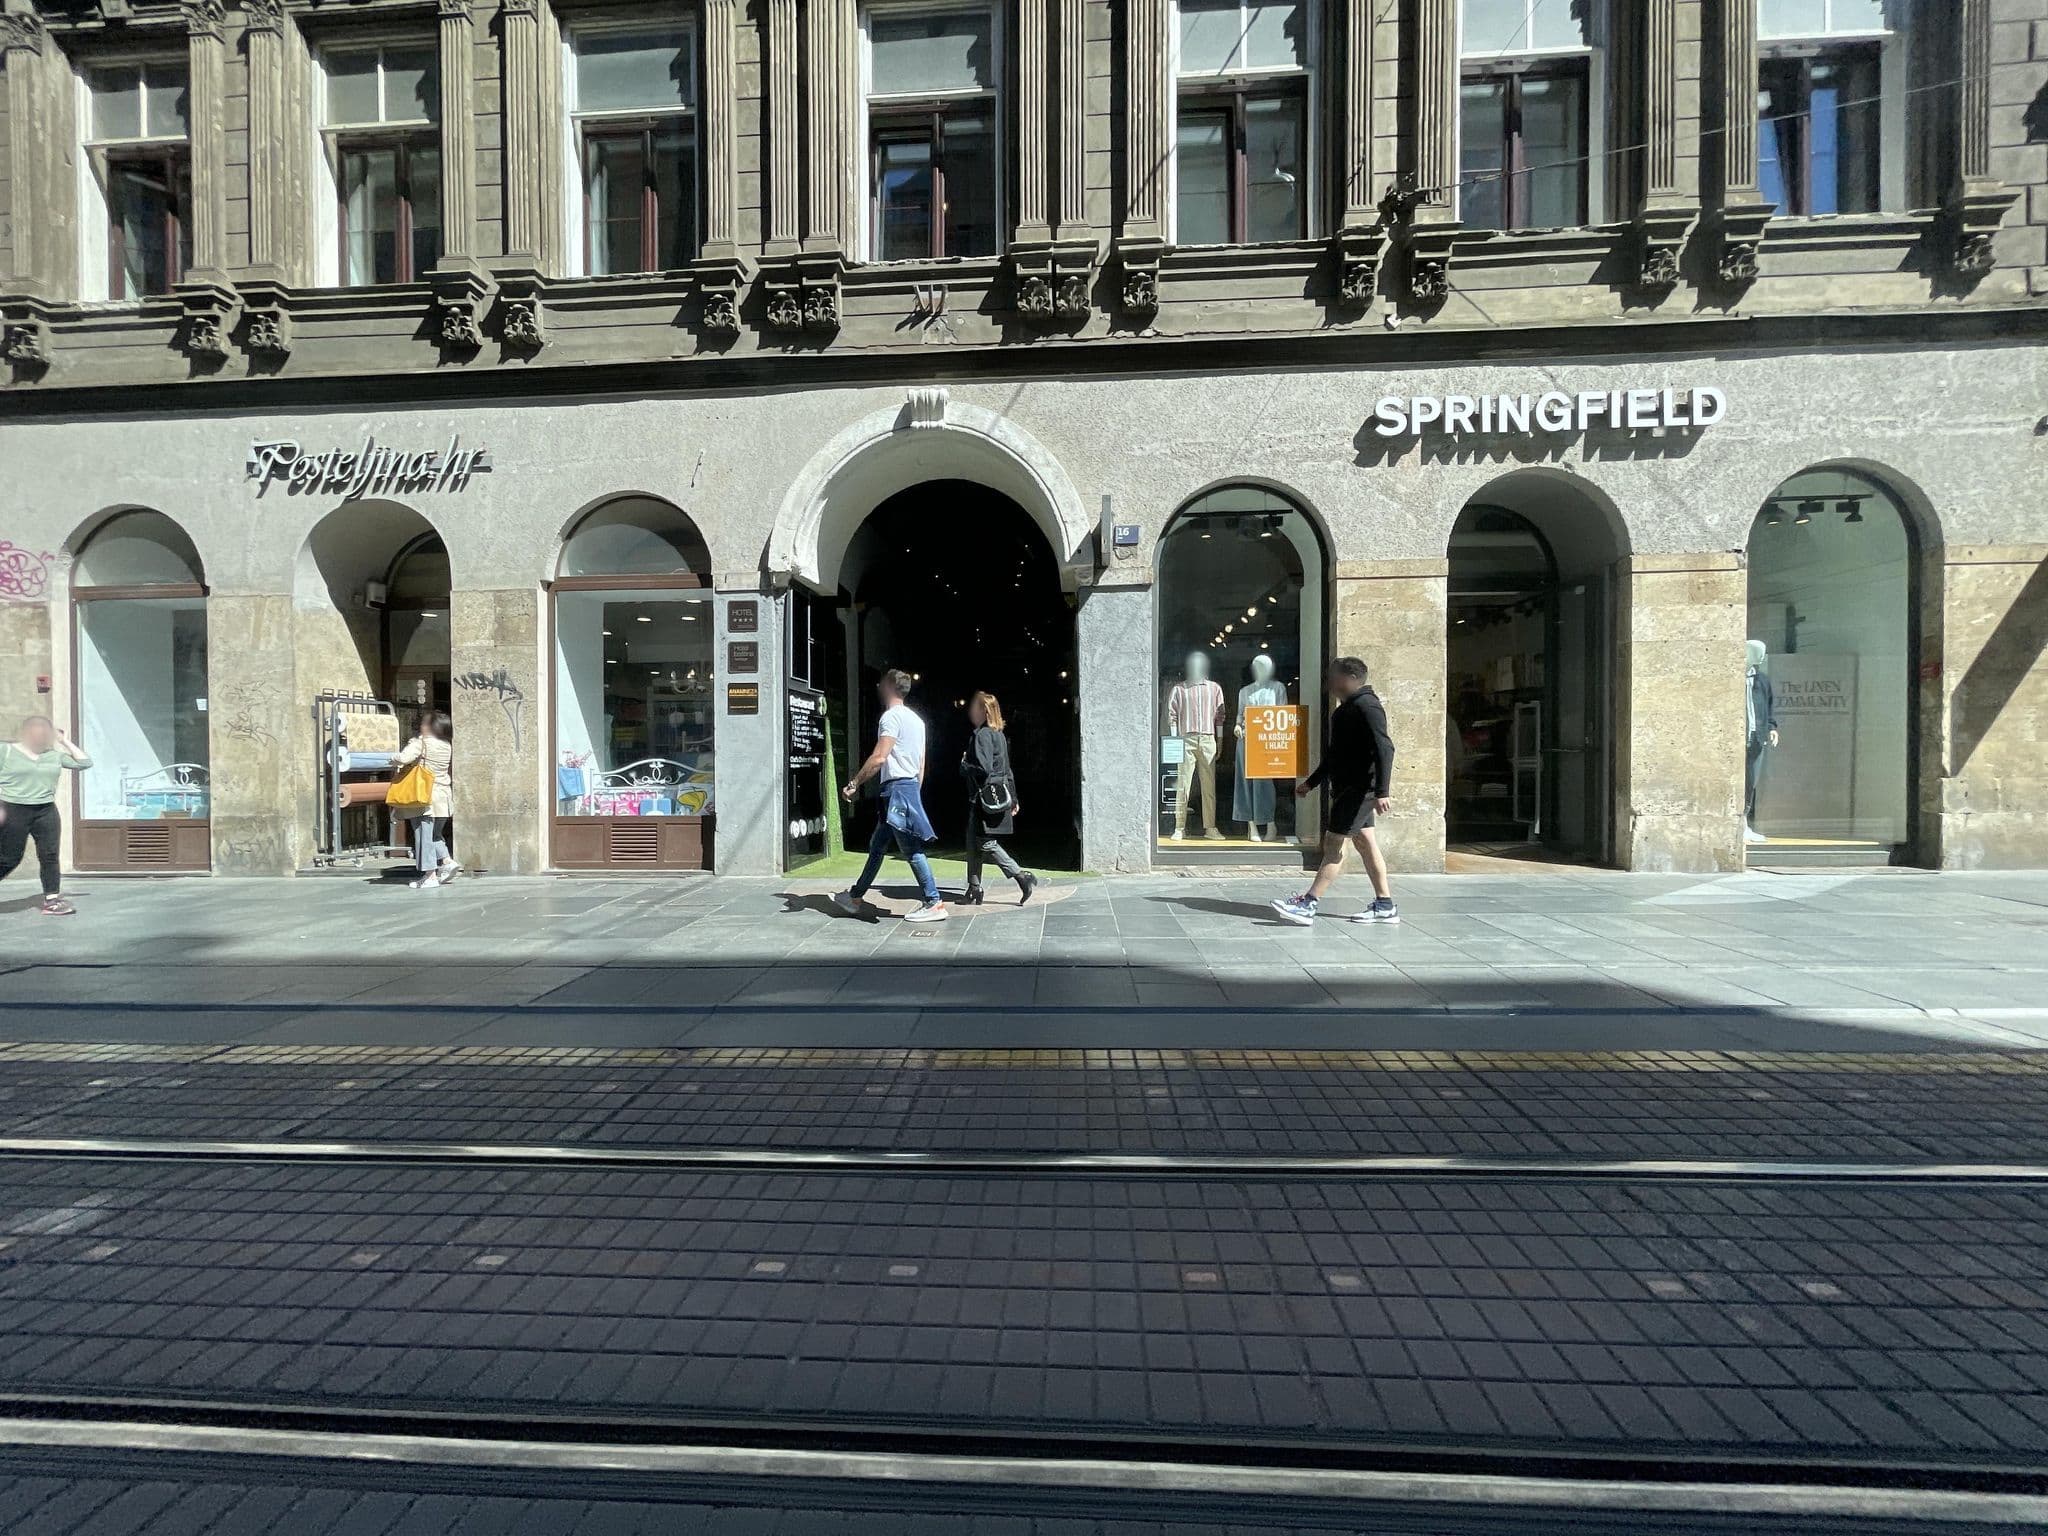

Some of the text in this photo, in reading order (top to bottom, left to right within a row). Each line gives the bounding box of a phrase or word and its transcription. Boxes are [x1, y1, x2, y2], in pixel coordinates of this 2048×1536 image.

[1373, 386, 1727, 437] SPRINGFIELD
[250, 434, 487, 499] Posteljina.hr
[1117, 527, 1130, 536] 16
[731, 608, 753, 616] HOTEL
[1780, 680, 1841, 693] The LINEN
[1252, 709, 1301, 731] -30%
[1258, 732, 1296, 741] NA KOŠULJE
[1269, 740, 1289, 750] HLAČE
